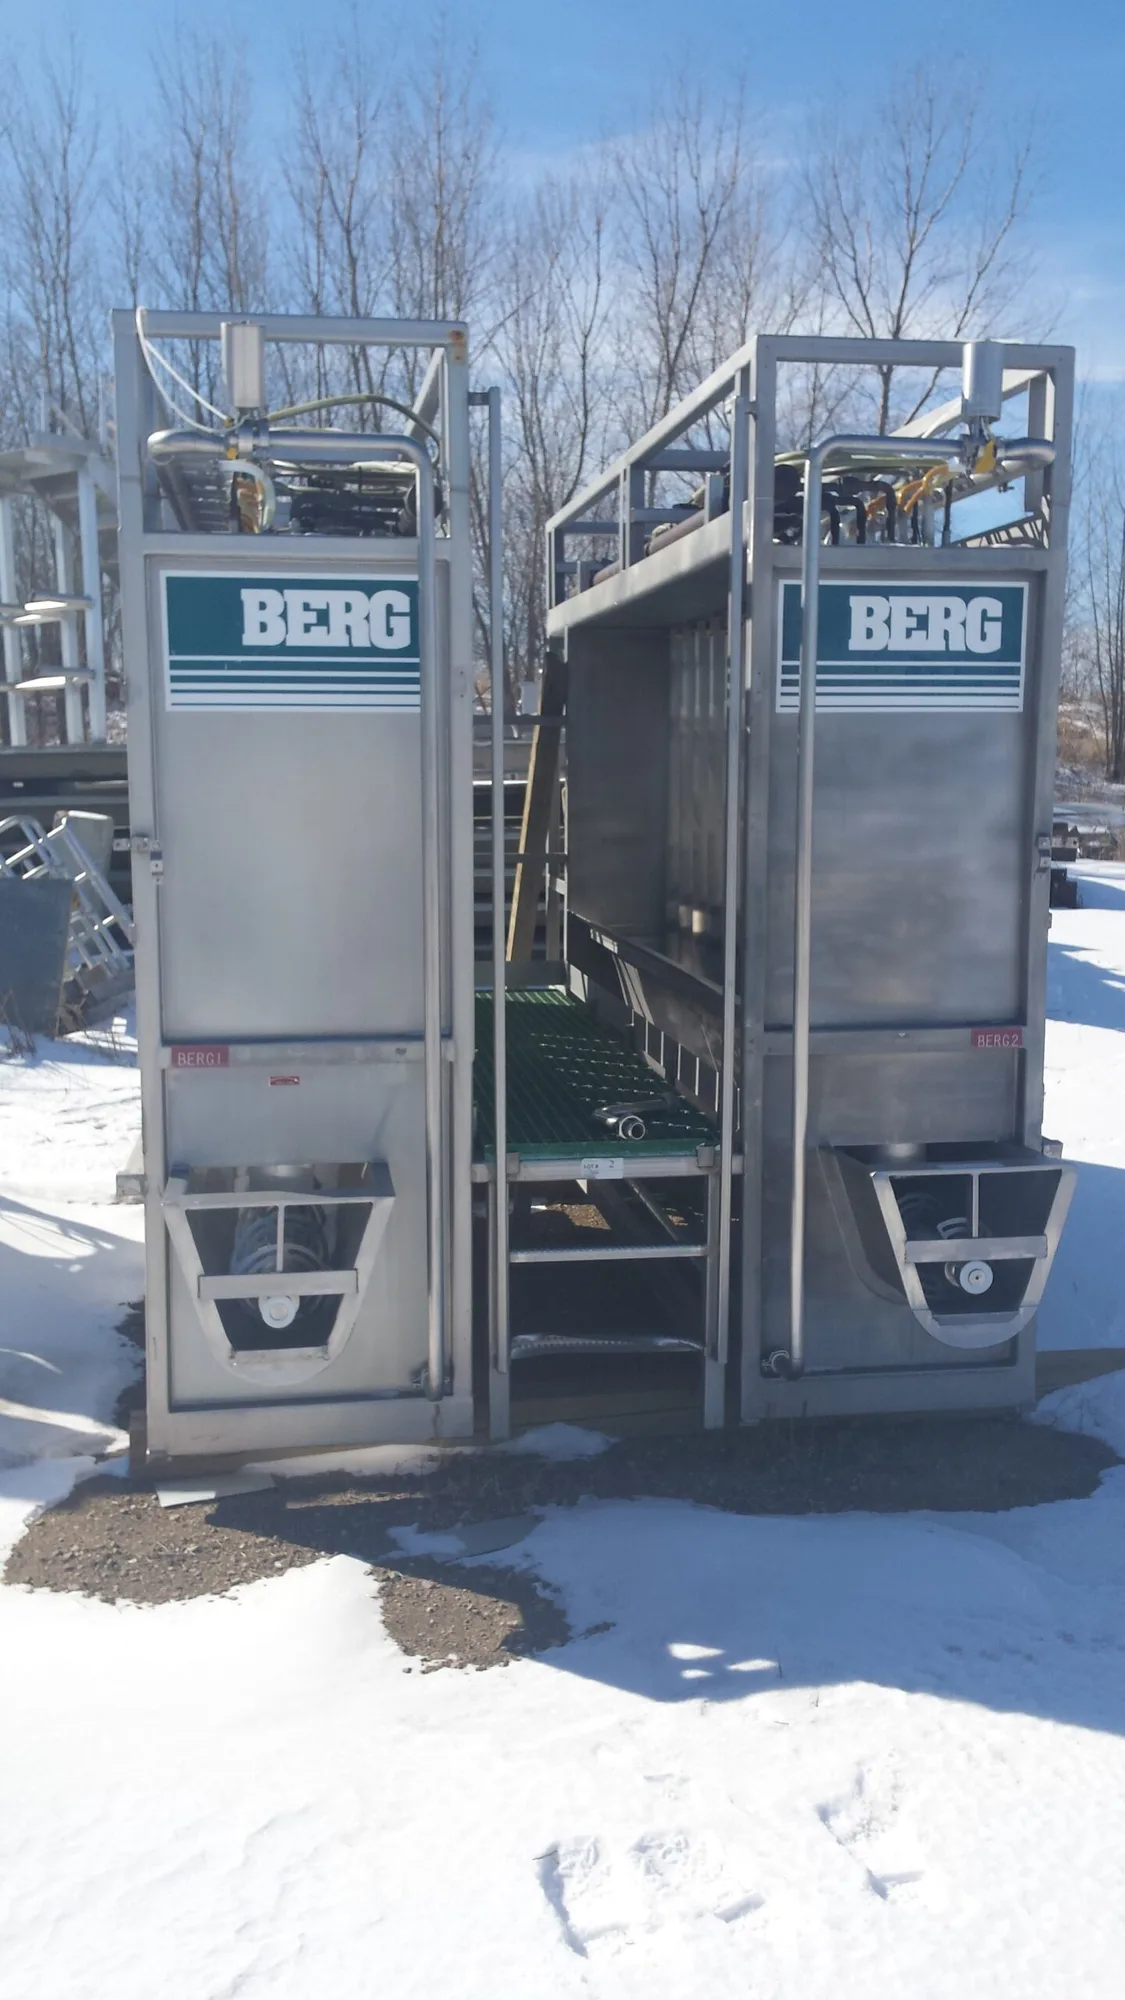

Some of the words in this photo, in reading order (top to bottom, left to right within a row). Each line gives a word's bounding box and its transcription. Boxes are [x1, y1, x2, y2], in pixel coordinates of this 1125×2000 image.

[240, 588, 411, 650] BERG
[848, 595, 1003, 654] BERG
[977, 1033, 1019, 1048] BERG2
